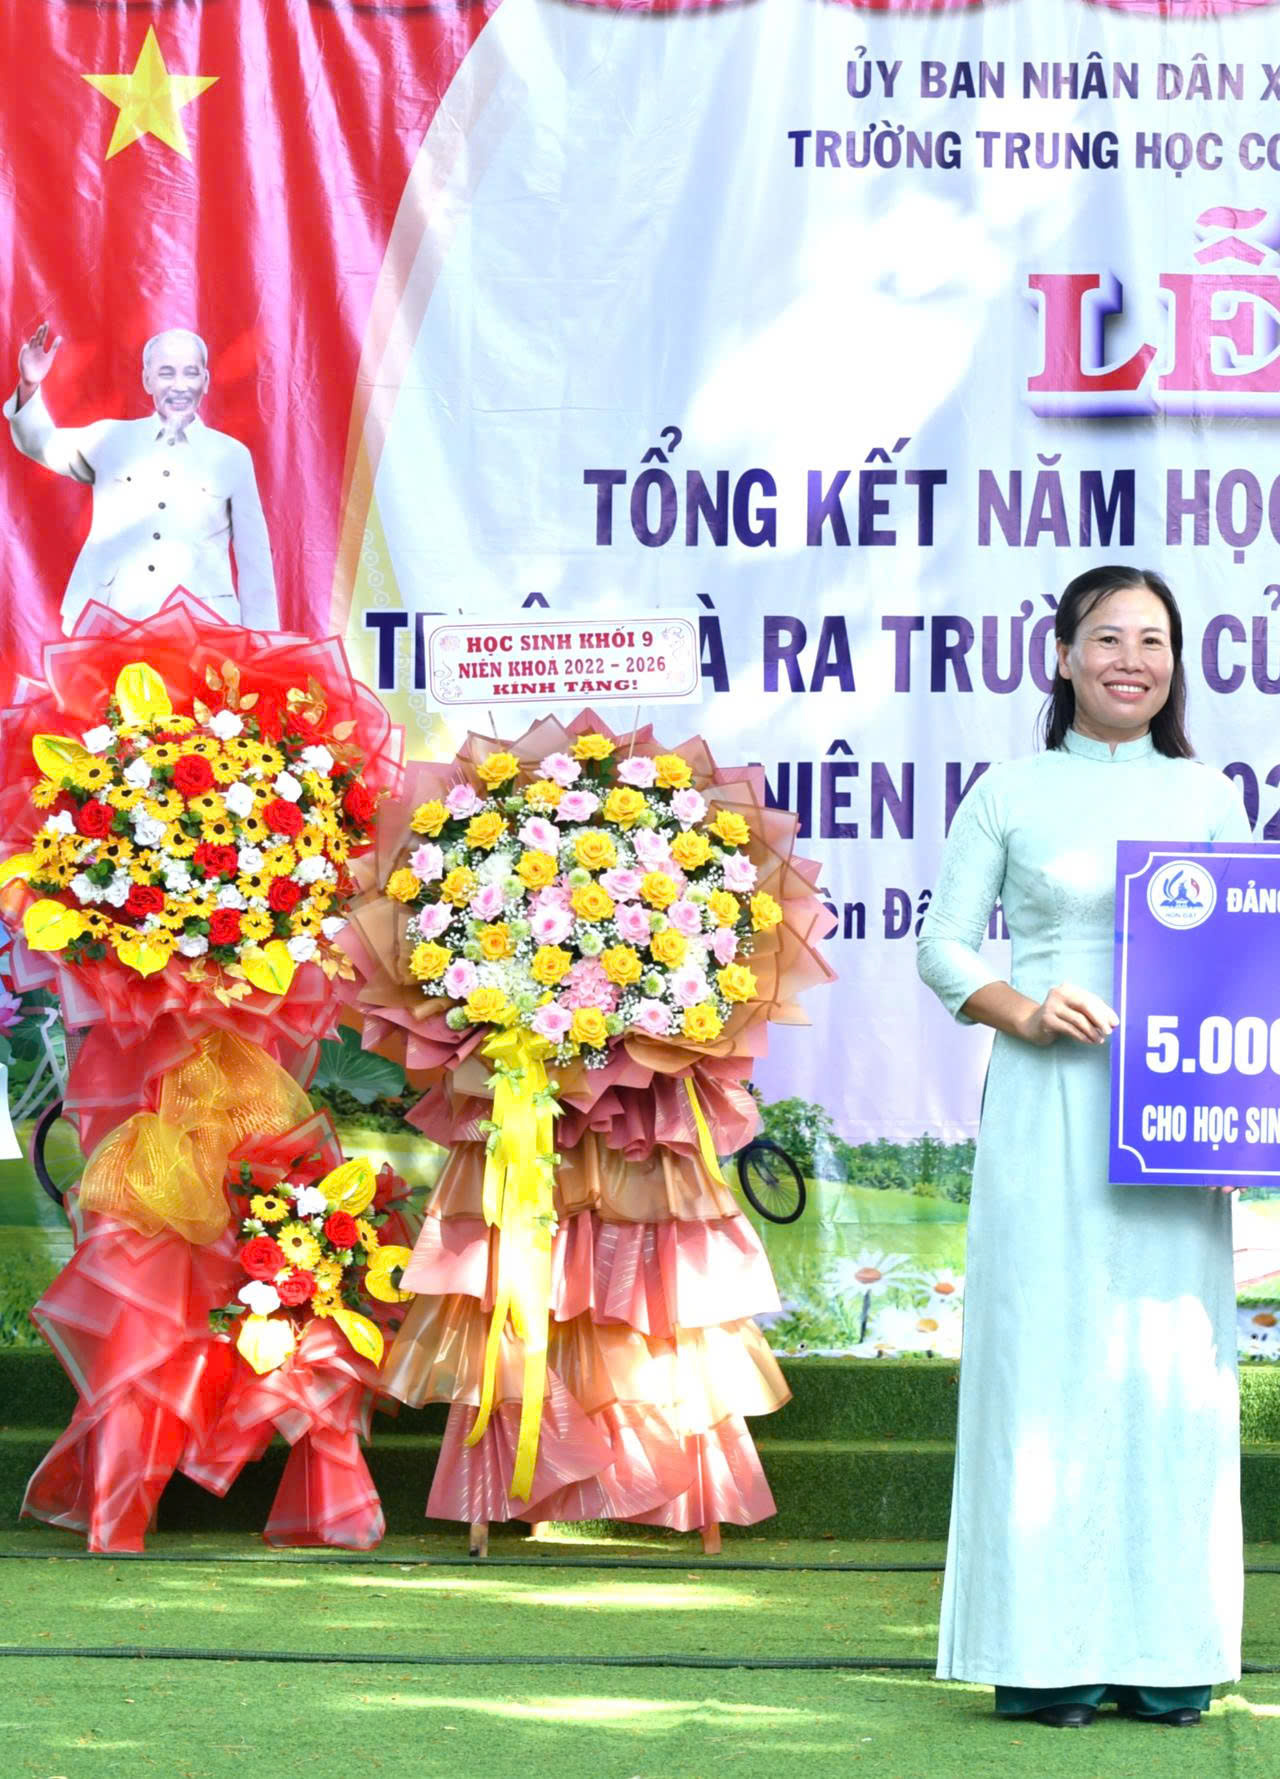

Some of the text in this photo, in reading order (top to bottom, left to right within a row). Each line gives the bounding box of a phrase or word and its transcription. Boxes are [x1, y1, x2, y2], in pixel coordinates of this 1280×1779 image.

[845, 46, 901, 99] ỦY
[920, 61, 1005, 99] BAN
[1022, 52, 1139, 100] NHÂN
[1158, 52, 1242, 100] DÂN
[787, 119, 962, 170] TRƯỜNG
[975, 130, 1119, 170] TRUNG
[1135, 131, 1223, 178] HỌC
[583, 425, 778, 548] TỔNG
[806, 437, 948, 547] KẾT
[976, 452, 1136, 548] NĂM
[467, 626, 653, 657] HỌC SINH KHỐI 9
[763, 613, 856, 694] RA
[881, 593, 1057, 695] TRƯỜ
[458, 658, 502, 679] NIÊN
[565, 657, 605, 675] 2022
[626, 655, 666, 674] 2026
[564, 678, 638, 696] TẶNG!
[1142, 1104, 1187, 1144] CHO
[1194, 1106, 1238, 1151] HỌC
